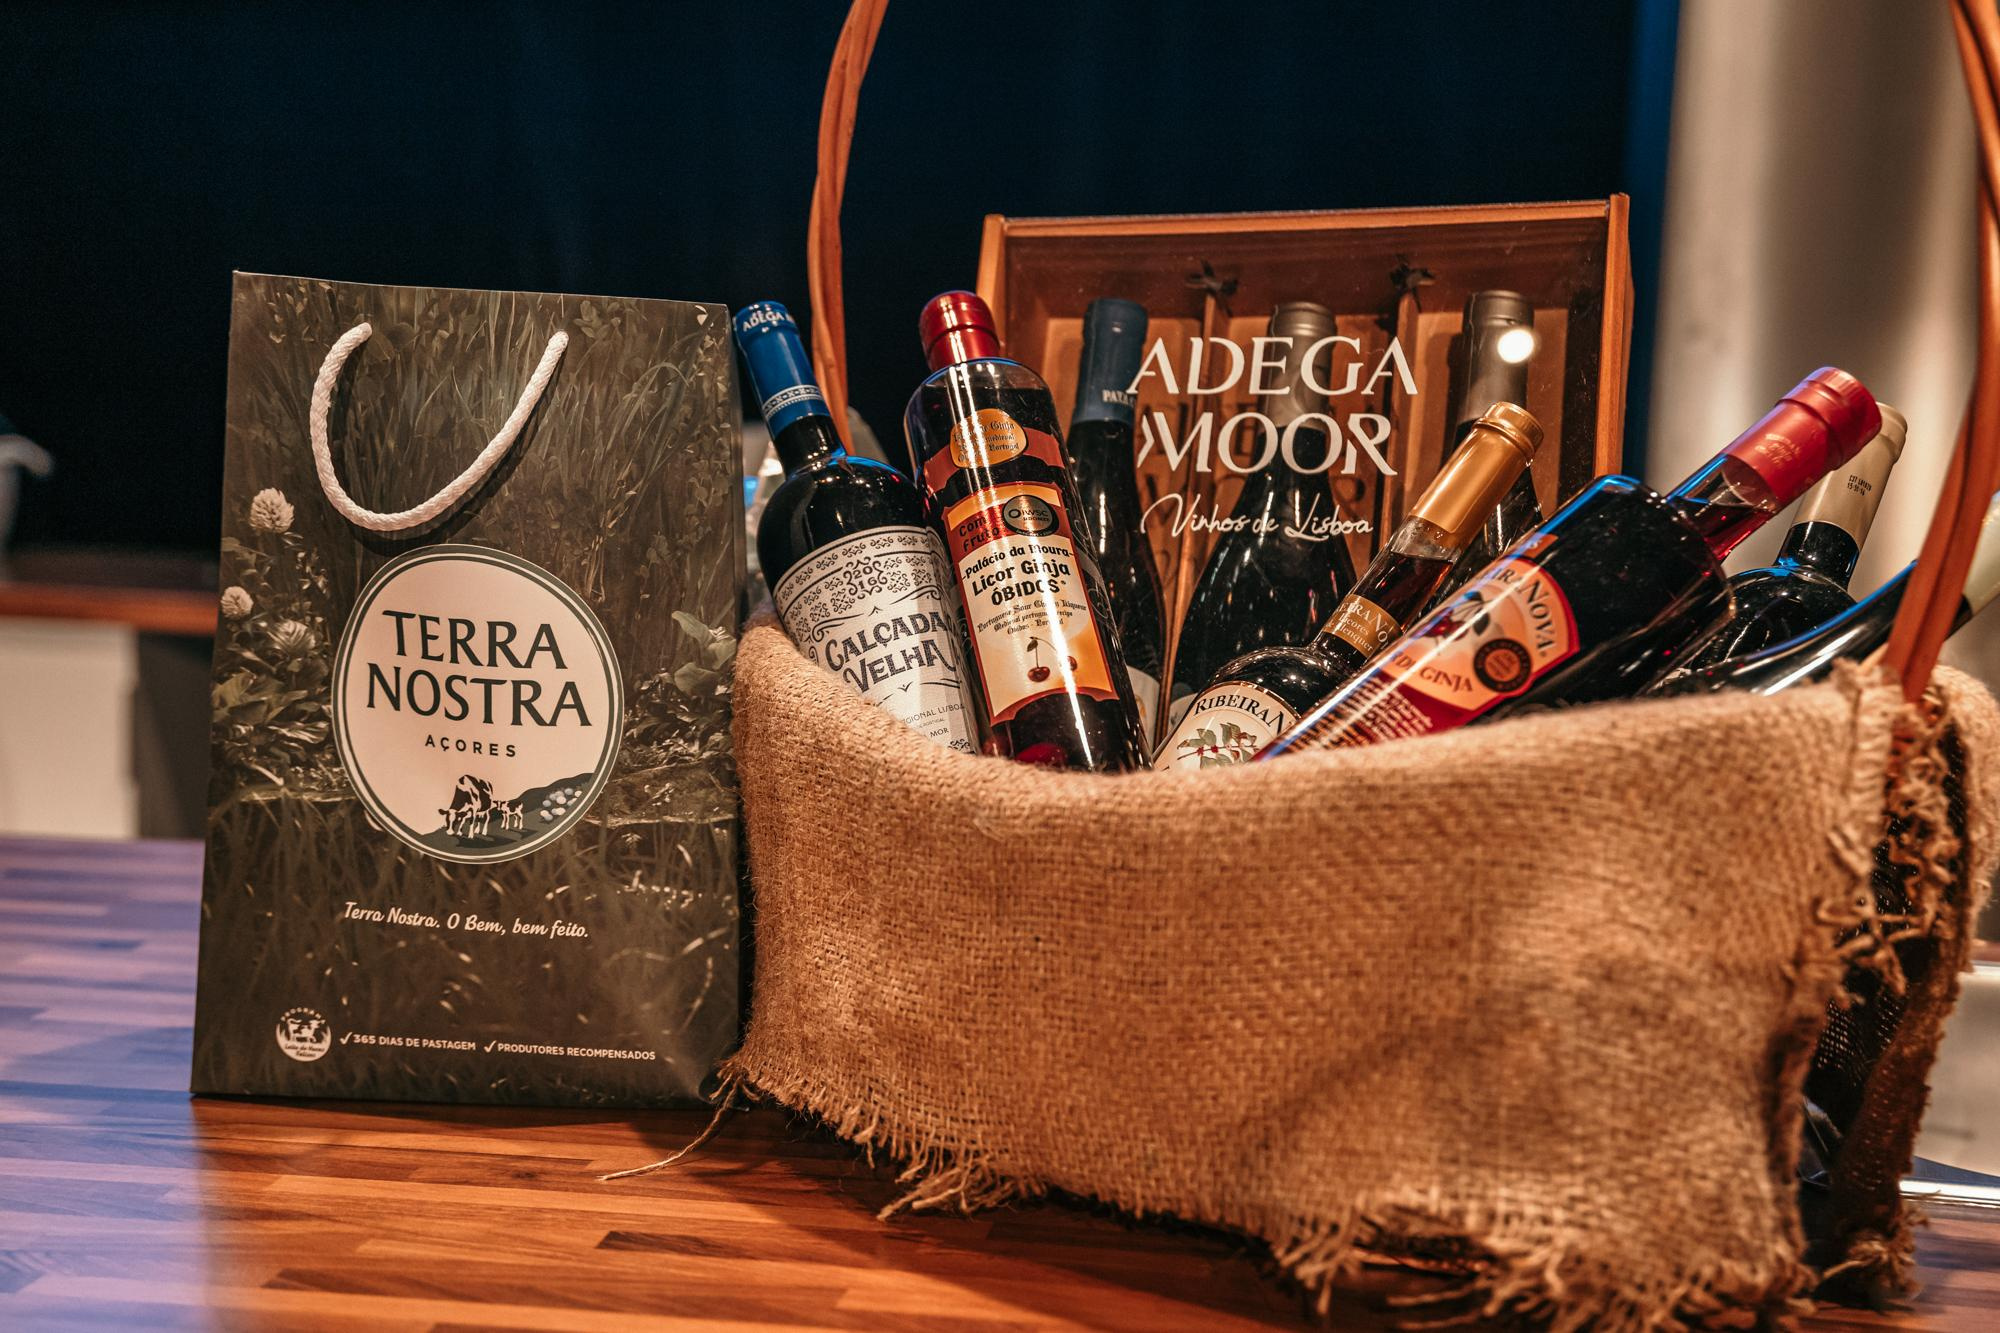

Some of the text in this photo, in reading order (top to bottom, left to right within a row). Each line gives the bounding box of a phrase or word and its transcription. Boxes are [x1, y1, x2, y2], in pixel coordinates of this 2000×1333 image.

[743, 310, 785, 332] ADEGA
[1126, 336, 1418, 396] ADEGA
[1136, 411, 1398, 477] MOOR
[1140, 492, 1374, 543] Vinhos de Lisboa
[1009, 546, 1026, 557] da
[972, 559, 1071, 597] Licor Ginja
[382, 609, 568, 670] TERRA
[825, 611, 950, 672] CALÇADA
[842, 639, 957, 693] VELHA
[1420, 667, 1474, 693] GINJA
[366, 662, 593, 727] NOSTRA
[425, 734, 517, 757] AÇORES
[344, 901, 590, 940] Terra Nostra. O Bem, bem feito.
[353, 1034, 477, 1051] 365 DIAS DE PASTAGEM
[497, 1041, 656, 1061] PRODUTORES RECOMPENSADOS
